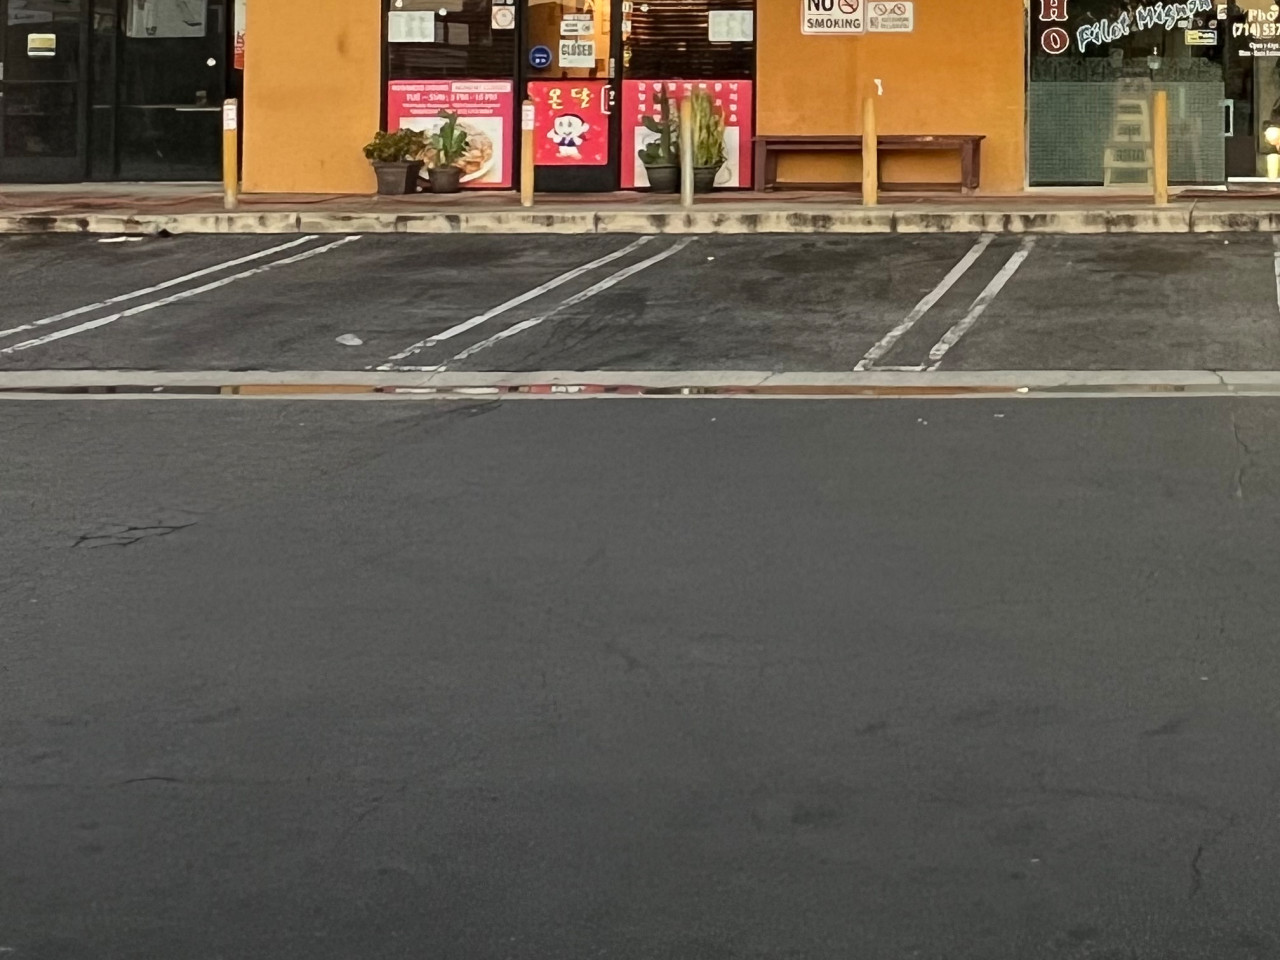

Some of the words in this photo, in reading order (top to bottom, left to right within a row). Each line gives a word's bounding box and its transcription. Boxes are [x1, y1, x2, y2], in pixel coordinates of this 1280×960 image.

[807, 18, 861, 29] SMOKING
[1232, 22, 1261, 38] (714)
[561, 43, 593, 57] CLOSED
